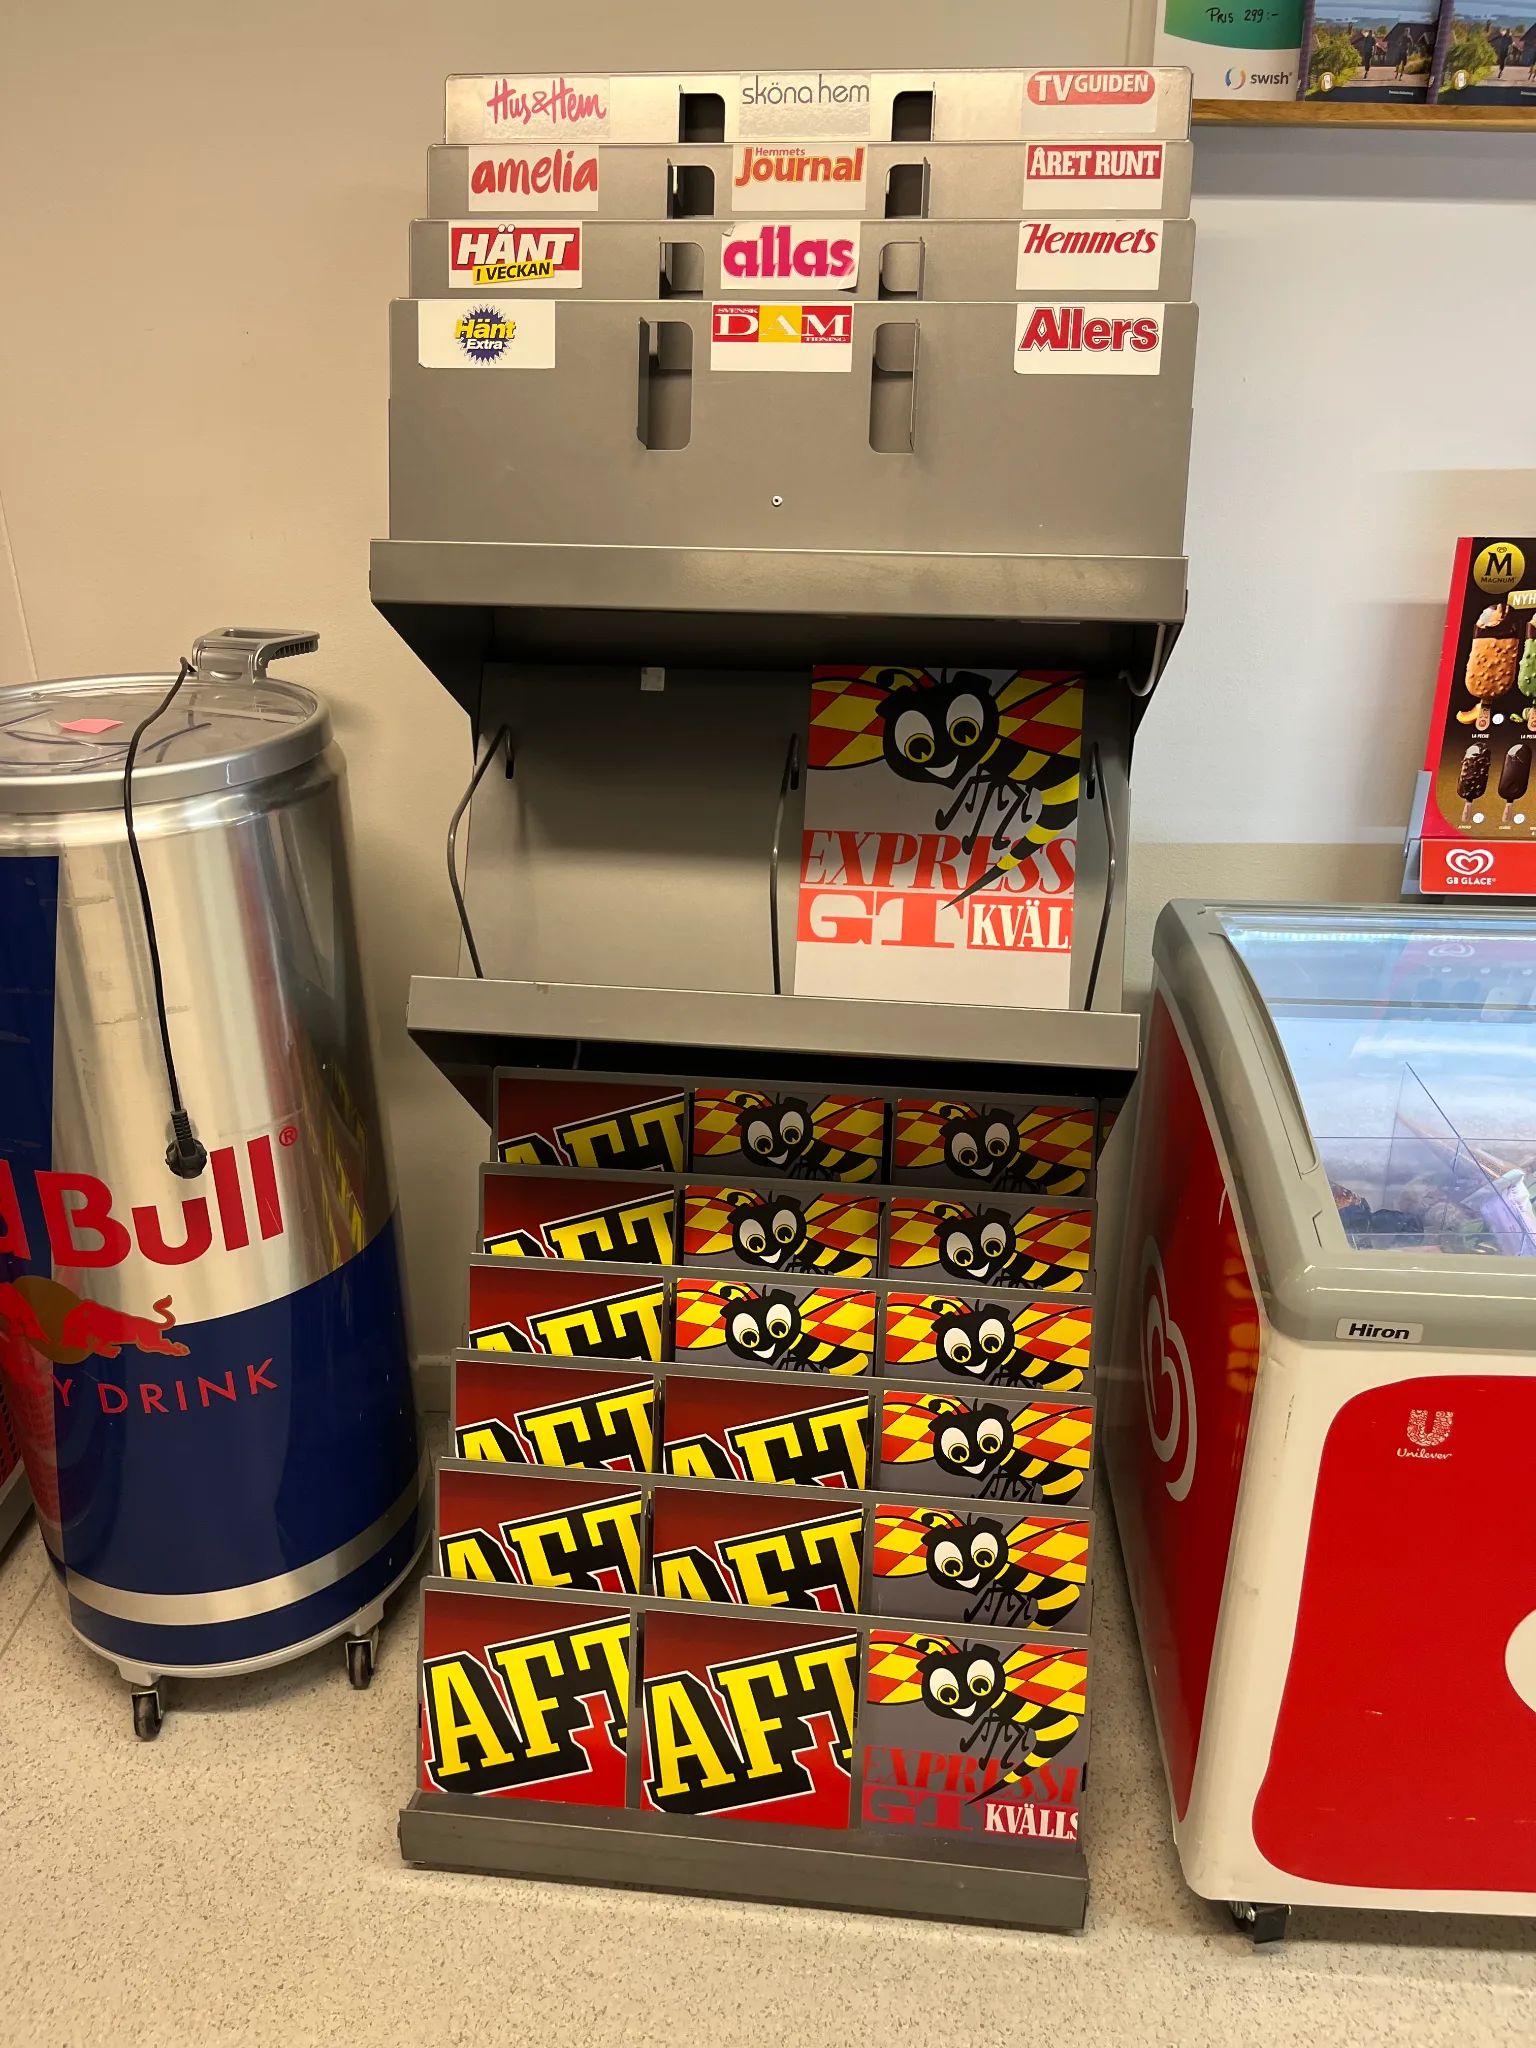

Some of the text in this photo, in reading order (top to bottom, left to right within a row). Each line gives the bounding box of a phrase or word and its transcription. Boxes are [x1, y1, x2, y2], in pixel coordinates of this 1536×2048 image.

[742, 73, 869, 105] sköna hem
[1250, 71, 1289, 85] swish
[755, 147, 805, 157] Hemmets
[1029, 148, 1159, 176] ÅRET RUNT
[471, 149, 598, 194] amelia
[456, 224, 575, 265] HÄNT
[1022, 223, 1159, 254] Hemmets
[724, 225, 855, 278] allas
[487, 261, 550, 280] VECKAN
[455, 318, 516, 339] Hänt
[1018, 307, 1160, 351] Allers
[466, 339, 503, 350] Extra
[1446, 876, 1492, 886] GB GLACE
[1349, 1323, 1410, 1340] Hiron
[97, 1358, 278, 1414] DRINK
[1396, 1448, 1452, 1460] Unilever
